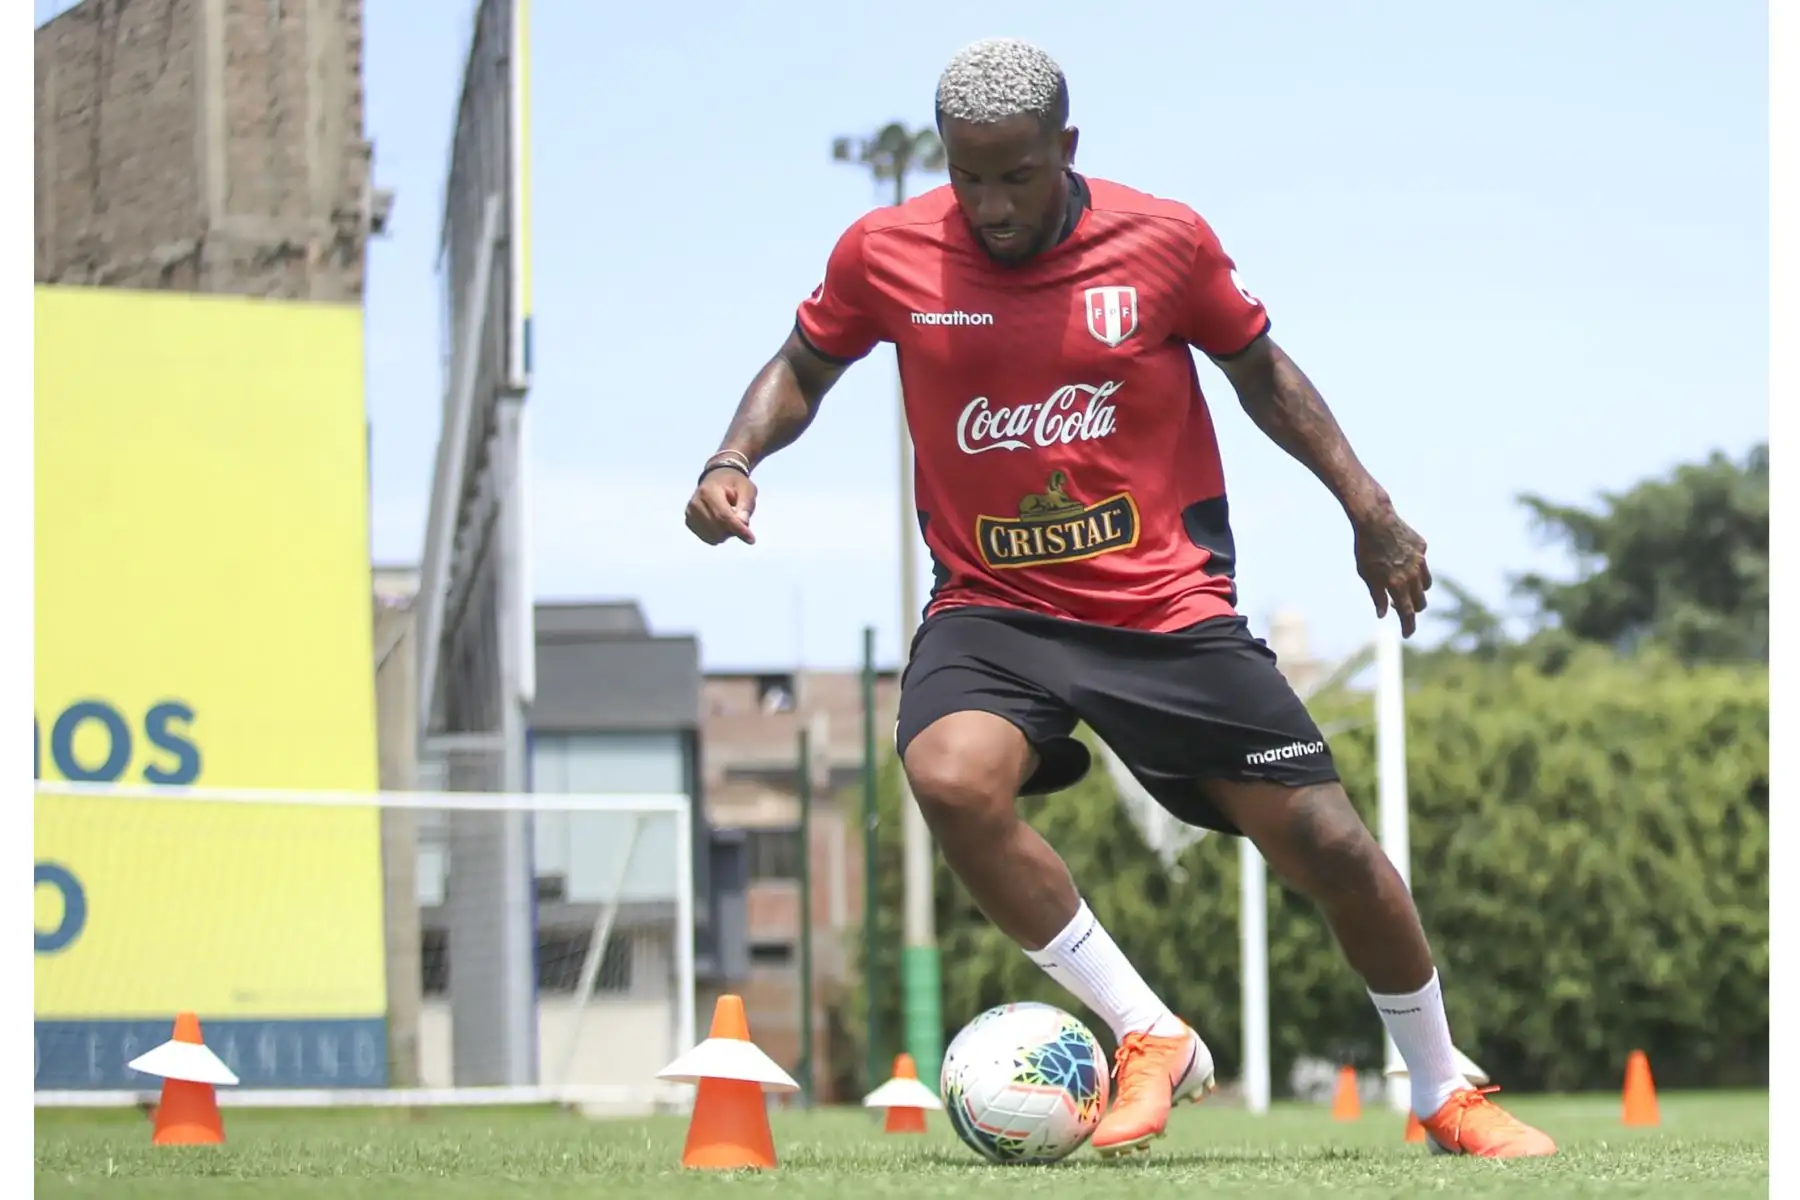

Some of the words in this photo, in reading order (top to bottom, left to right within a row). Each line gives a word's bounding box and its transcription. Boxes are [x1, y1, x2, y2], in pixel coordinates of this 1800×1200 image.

[911, 310, 994, 326] marathon
[957, 380, 1125, 454] Coca-Cola
[990, 510, 1121, 558] CRISTAL
[1246, 741, 1324, 765] marathon
